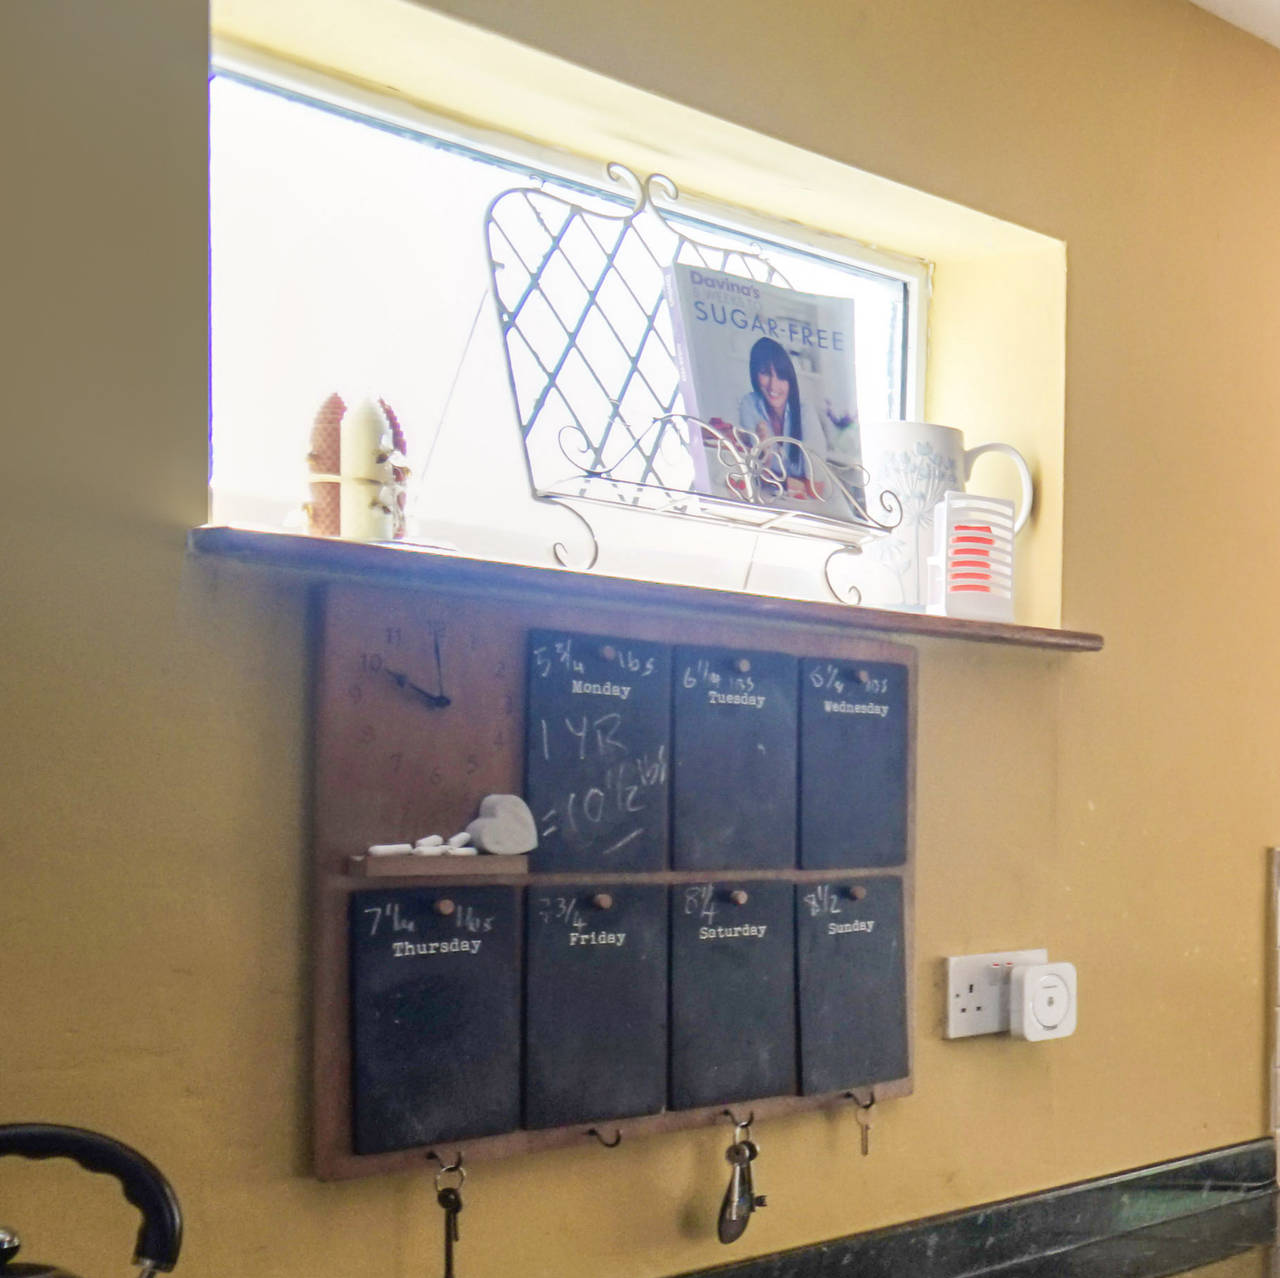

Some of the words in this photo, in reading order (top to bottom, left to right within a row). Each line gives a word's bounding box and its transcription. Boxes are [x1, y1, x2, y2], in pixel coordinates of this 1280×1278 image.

[690, 270, 760, 299] Davina's
[693, 300, 845, 351] SUGAR-FREE
[360, 653, 384, 674] 10
[571, 679, 632, 700] Monday
[708, 690, 767, 709] Tuesday
[823, 700, 890, 718] Wednesday
[564, 712, 628, 760] YR
[699, 923, 768, 940] Saturday
[827, 919, 876, 935] Sunday
[392, 938, 482, 958] Thursday
[569, 931, 626, 947] Friday
